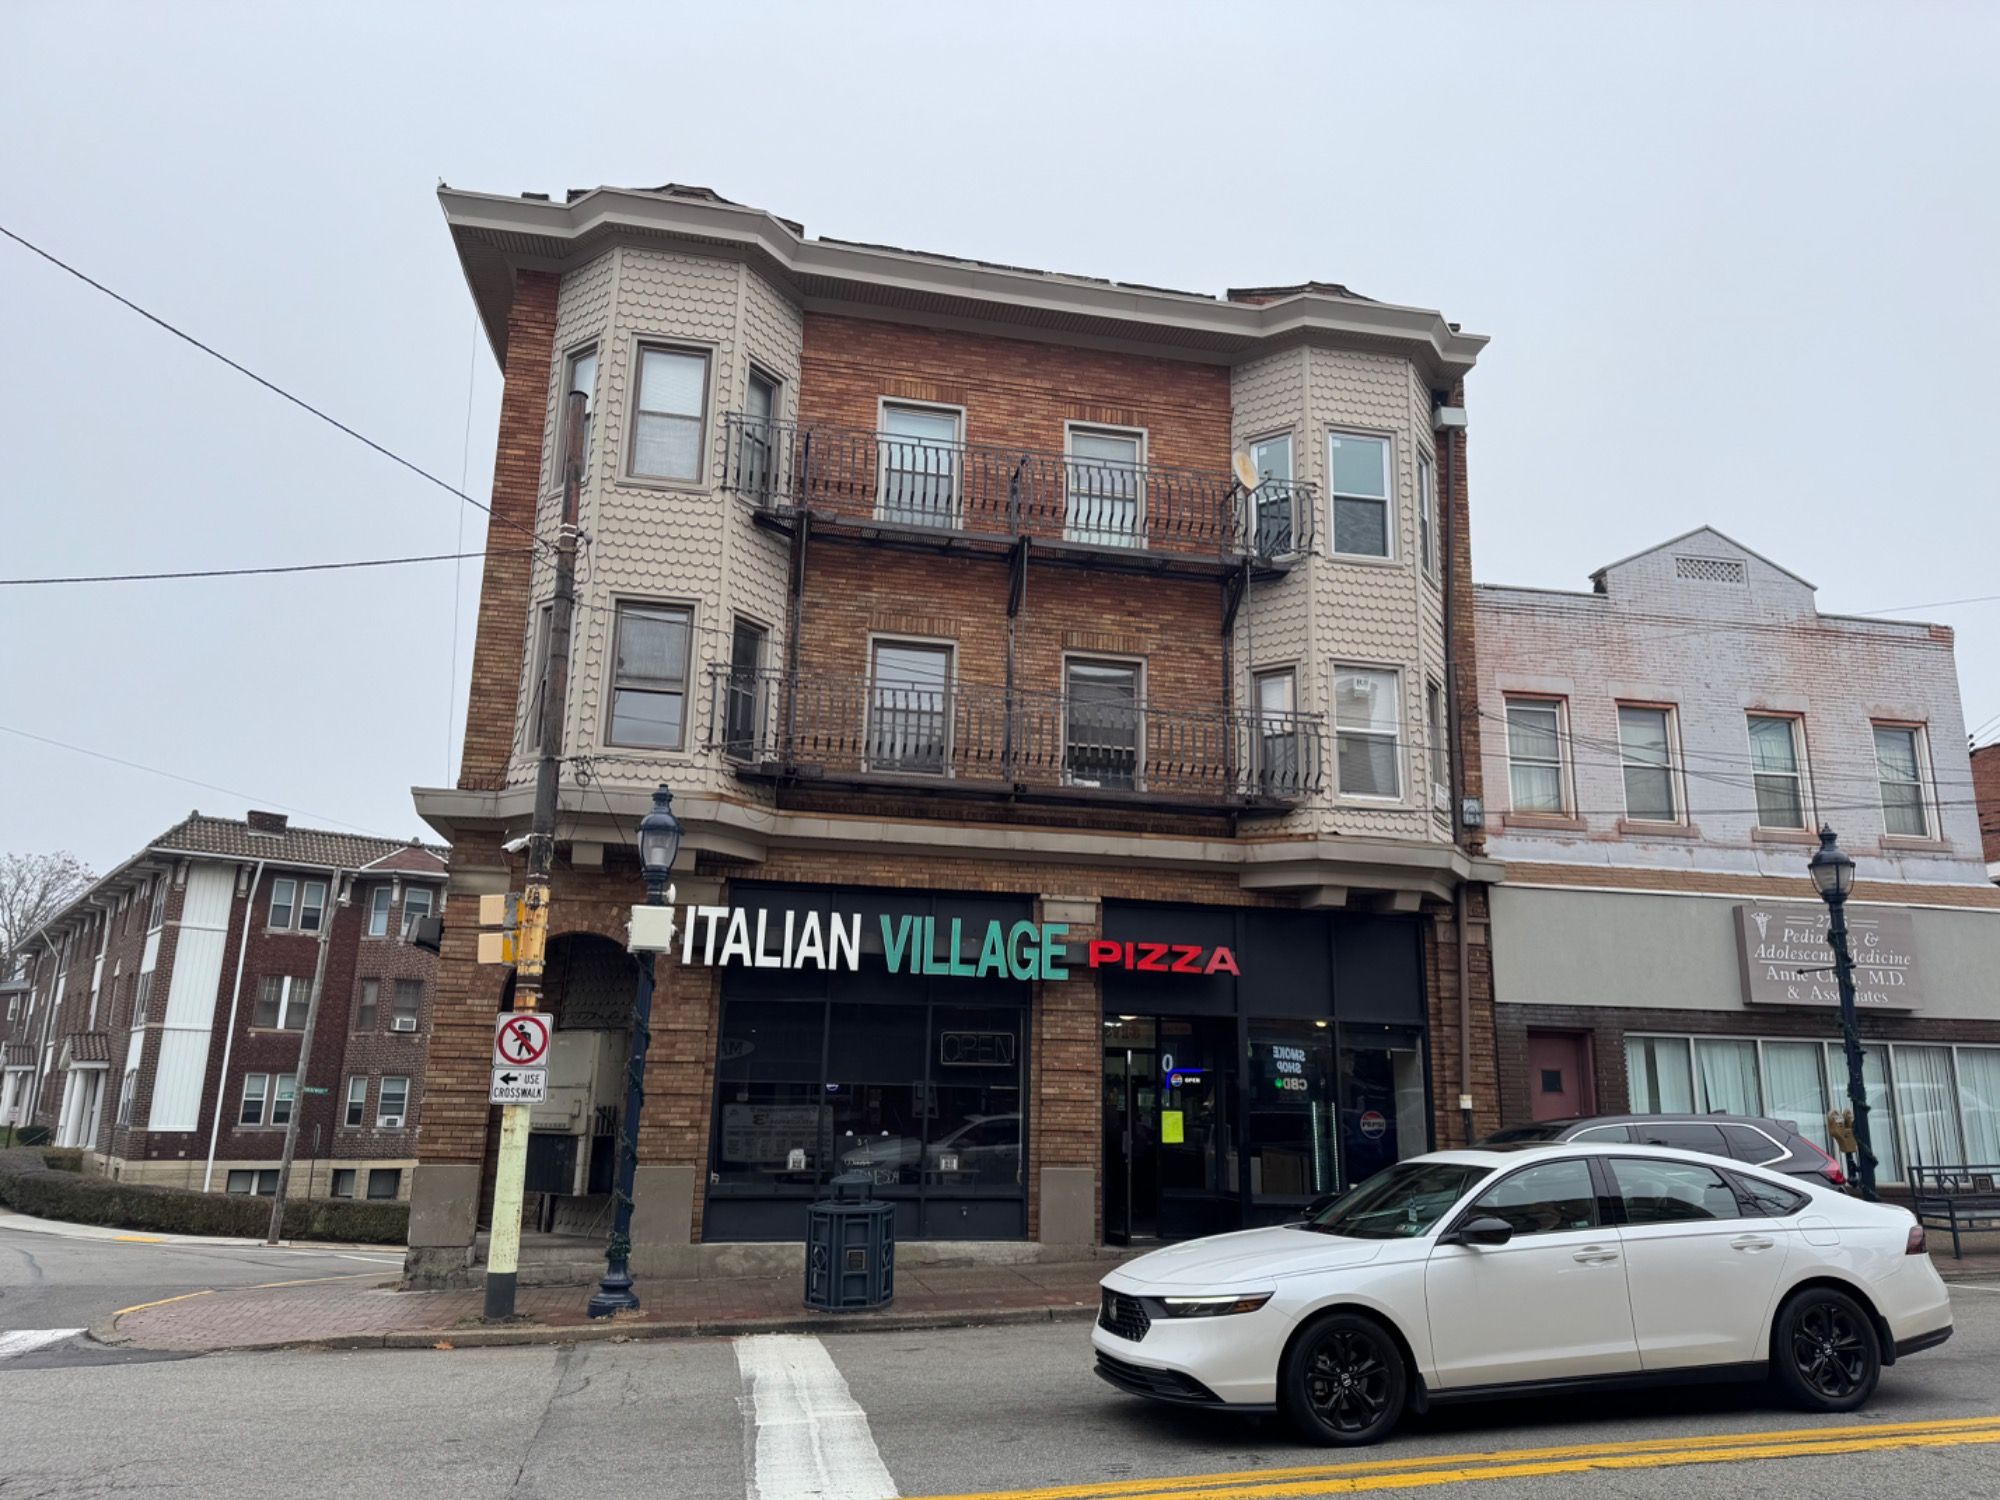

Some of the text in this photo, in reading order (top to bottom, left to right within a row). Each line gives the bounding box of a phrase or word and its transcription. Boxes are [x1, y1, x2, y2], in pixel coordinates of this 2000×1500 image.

[681, 905, 1241, 981] ITALIAN VILLAGE PIZZA
[1864, 931, 1880, 947] &
[1754, 943, 1835, 962] Adolescent
[1766, 965, 1809, 982] Anne
[1869, 971, 1906, 987] M.D.
[1787, 984, 1800, 1000] &
[943, 1035, 1011, 1062] OPEN
[524, 1073, 541, 1085] USE
[494, 1087, 543, 1098] CROSSWALK
